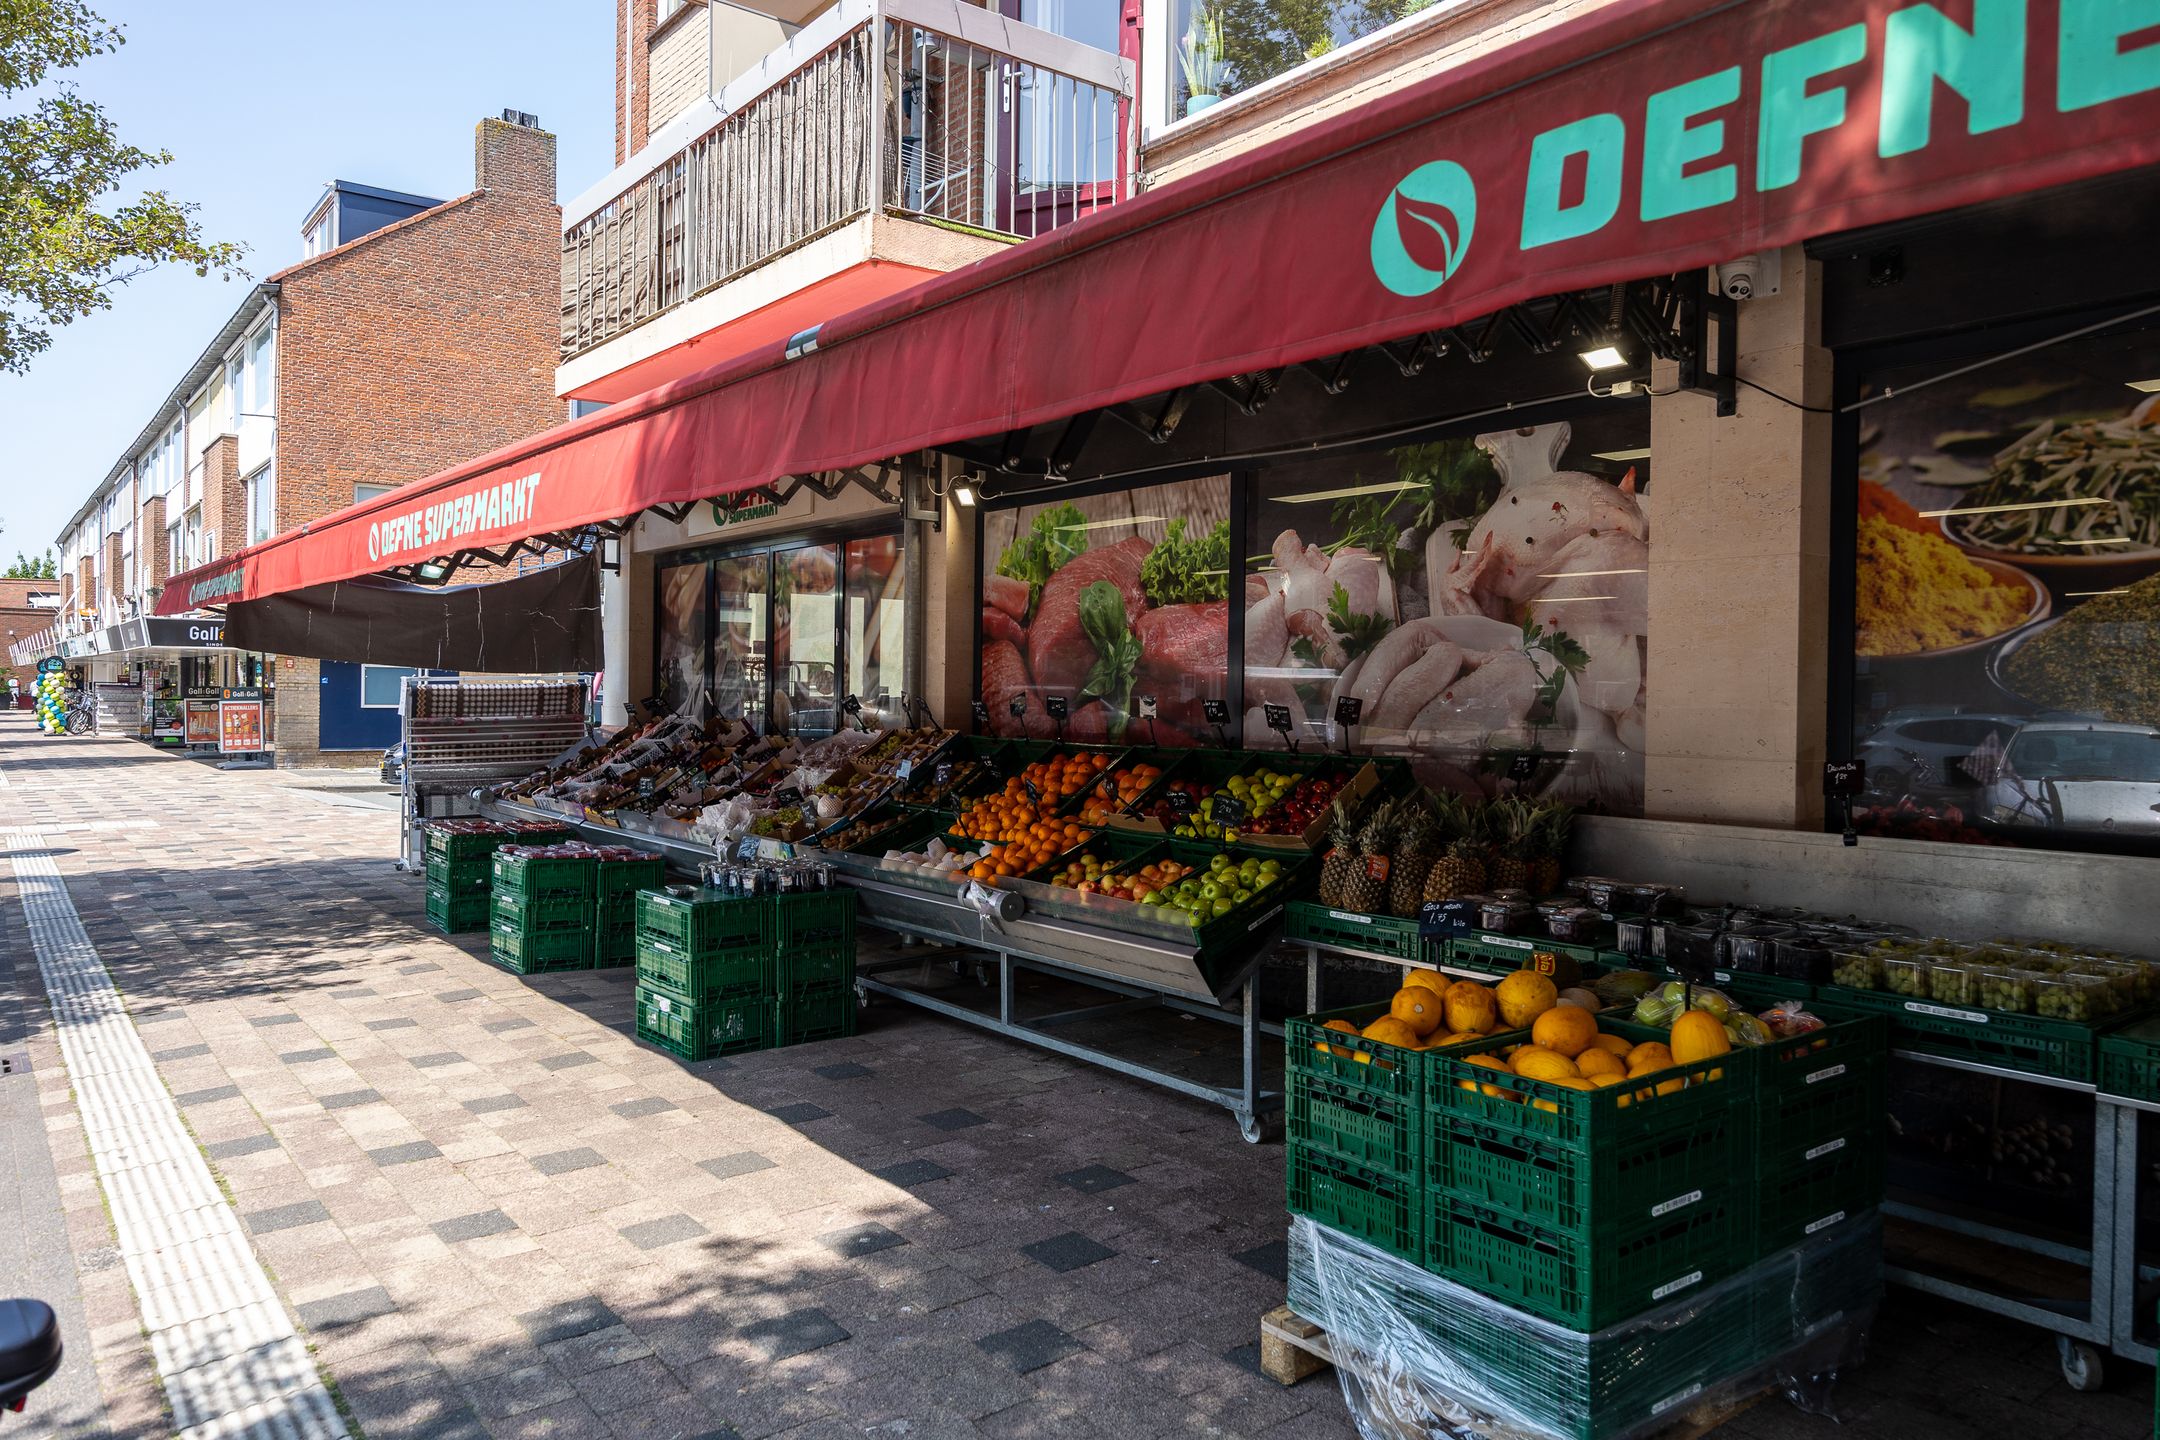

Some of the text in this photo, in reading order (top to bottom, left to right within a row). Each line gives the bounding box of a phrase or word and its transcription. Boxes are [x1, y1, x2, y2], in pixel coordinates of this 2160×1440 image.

[381, 472, 541, 556] DEFNE SUPERMARKT
[189, 625, 219, 641] Gall
